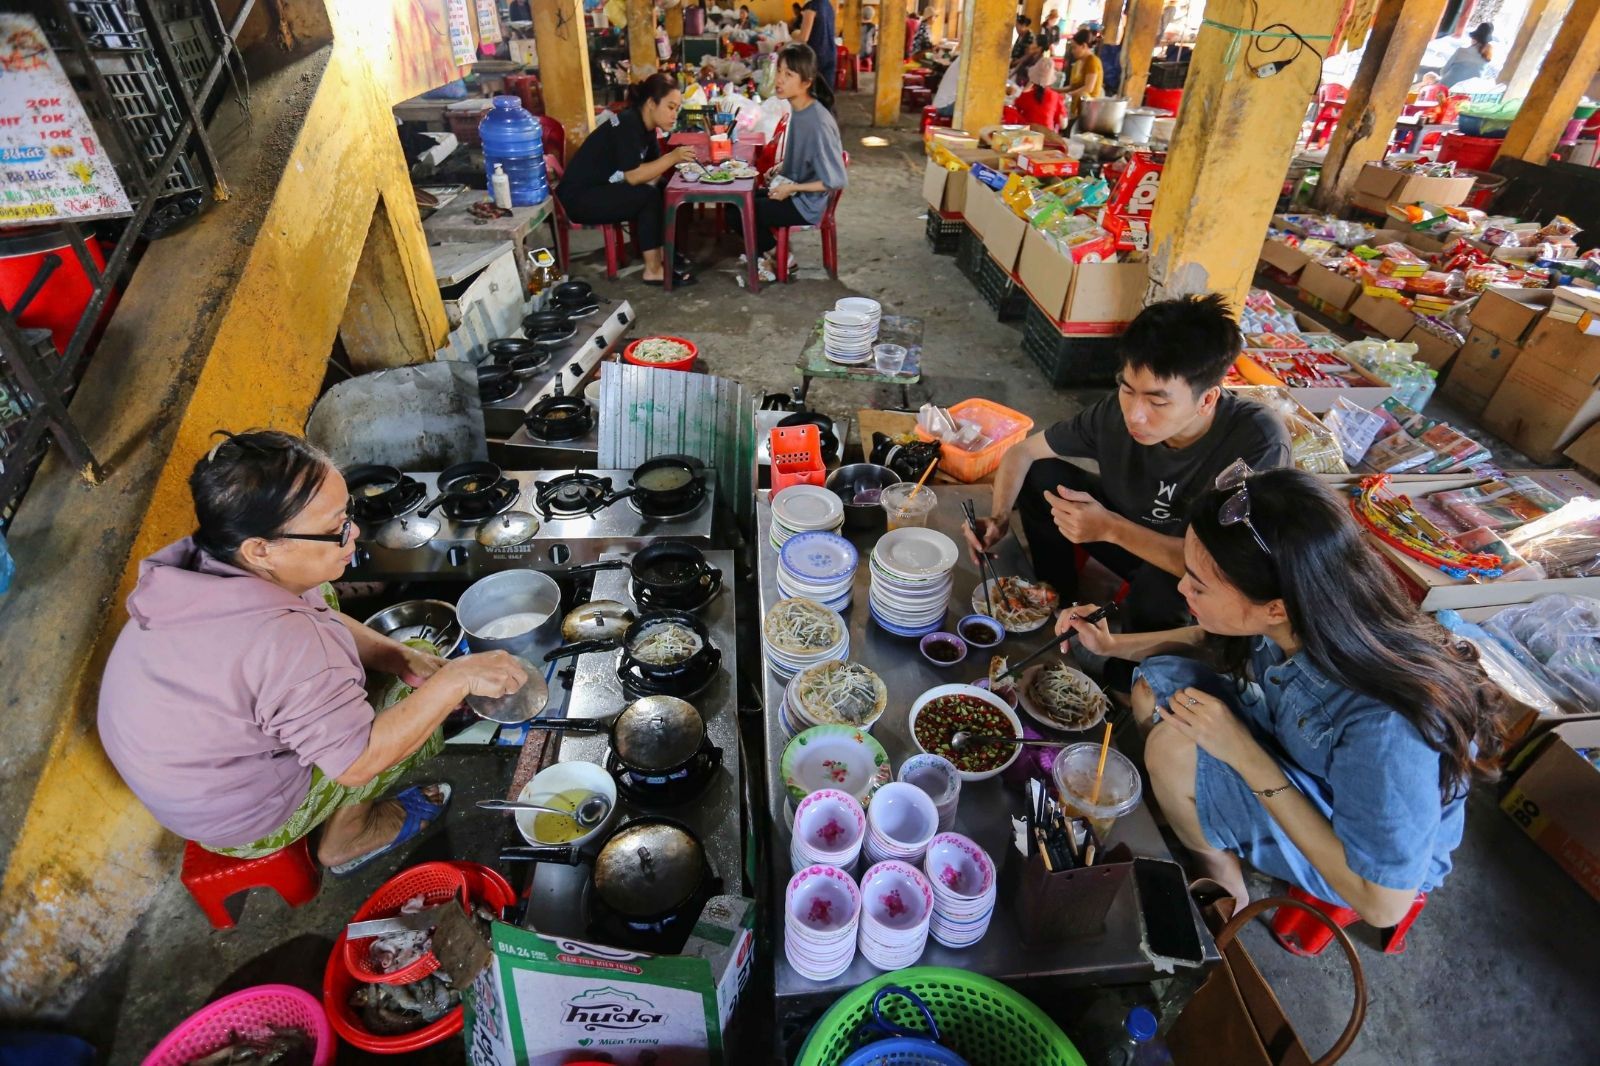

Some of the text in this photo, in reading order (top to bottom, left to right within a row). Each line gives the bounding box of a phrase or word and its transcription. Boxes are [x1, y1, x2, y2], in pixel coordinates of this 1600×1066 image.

[26, 98, 62, 108] 20K
[32, 114, 64, 124] 10K
[40, 129, 73, 139] 10K
[1127, 171, 1159, 214] TOP
[498, 941, 515, 955] BIA
[517, 946, 530, 957] 24
[566, 1004, 663, 1027] huda
[626, 1037, 660, 1046] Trung
